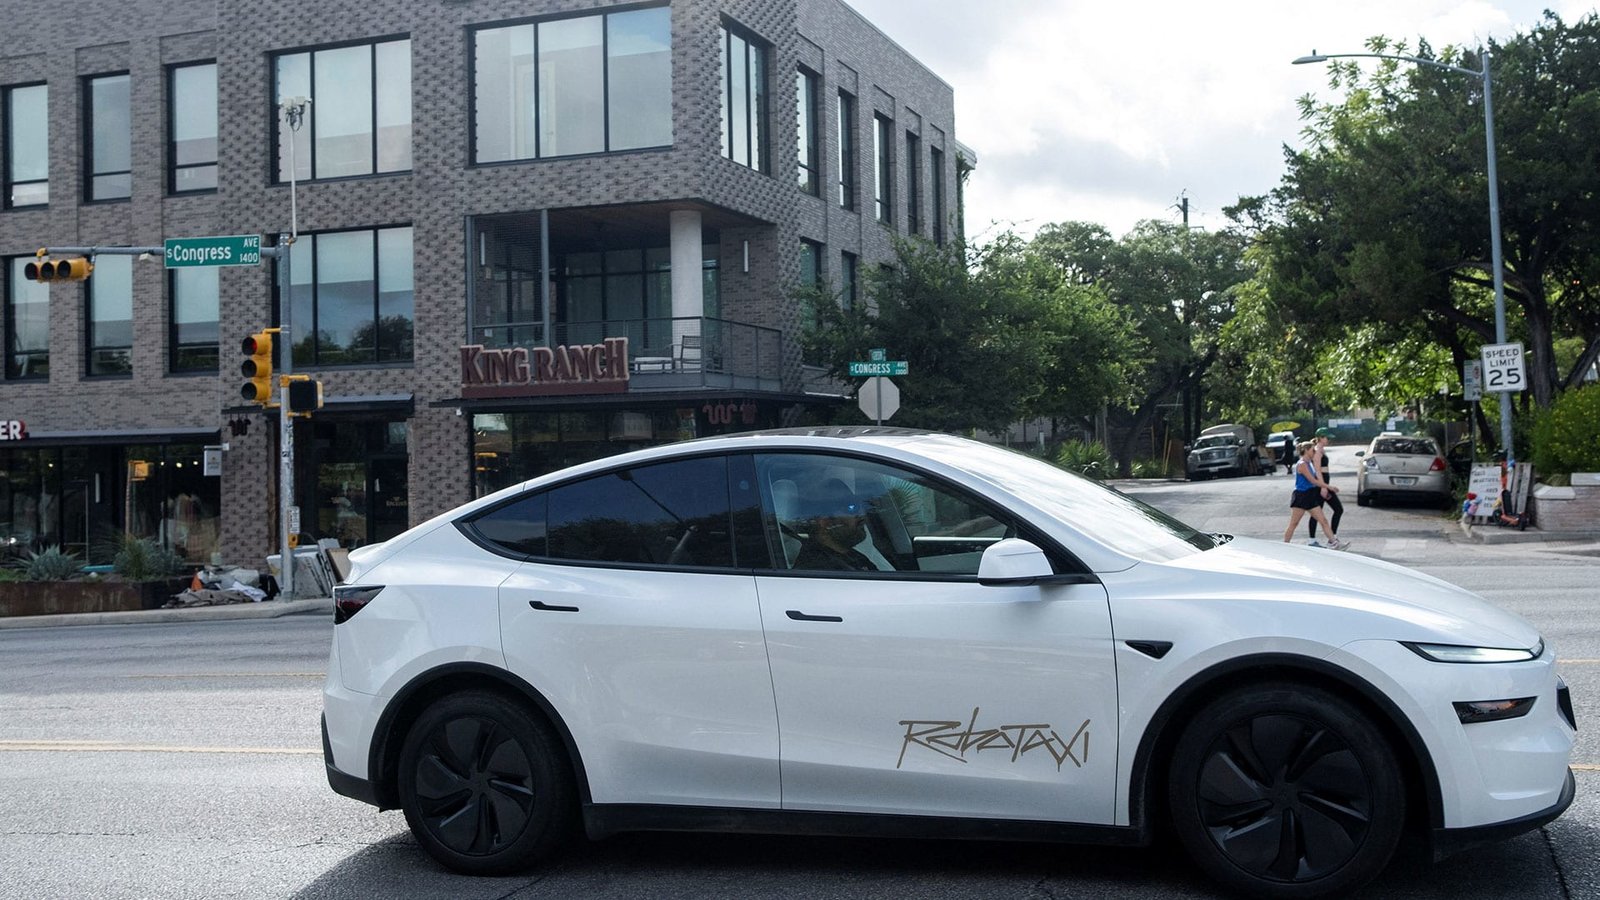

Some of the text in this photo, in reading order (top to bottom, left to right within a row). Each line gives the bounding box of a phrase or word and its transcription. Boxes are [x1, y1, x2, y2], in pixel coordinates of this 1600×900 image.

[167, 238, 258, 264] S Congress AVE
[240, 252, 258, 263] 1400
[1485, 348, 1520, 359] SPEED
[460, 337, 630, 386] KING RANCH
[854, 363, 891, 374] CONGRESS
[1489, 358, 1516, 368] LIMIT
[1488, 367, 1521, 387] 25
[0, 420, 22, 440] ER
